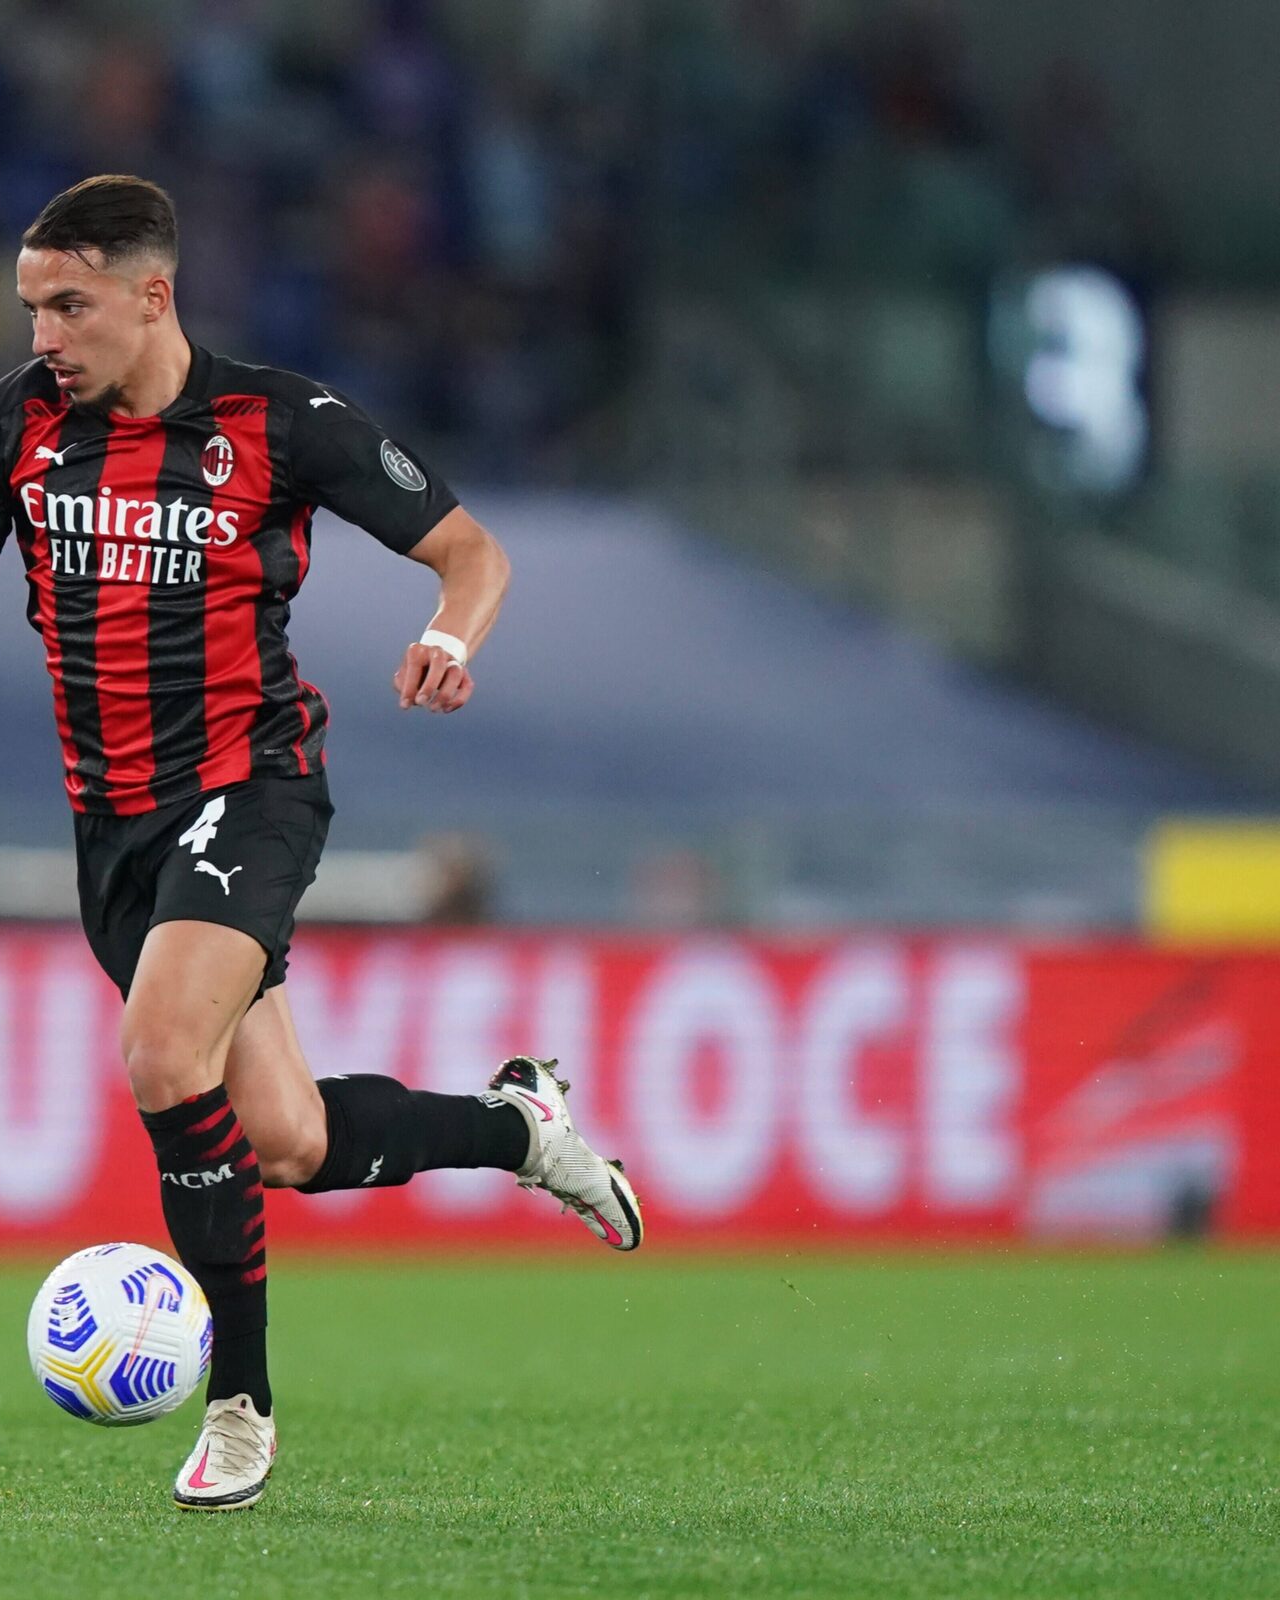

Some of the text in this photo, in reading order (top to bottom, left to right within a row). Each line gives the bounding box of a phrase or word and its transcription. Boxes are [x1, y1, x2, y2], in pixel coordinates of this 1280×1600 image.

[20, 482, 239, 546] Emirates
[51, 538, 202, 584] FLY BETTER
[178, 795, 226, 854] 4
